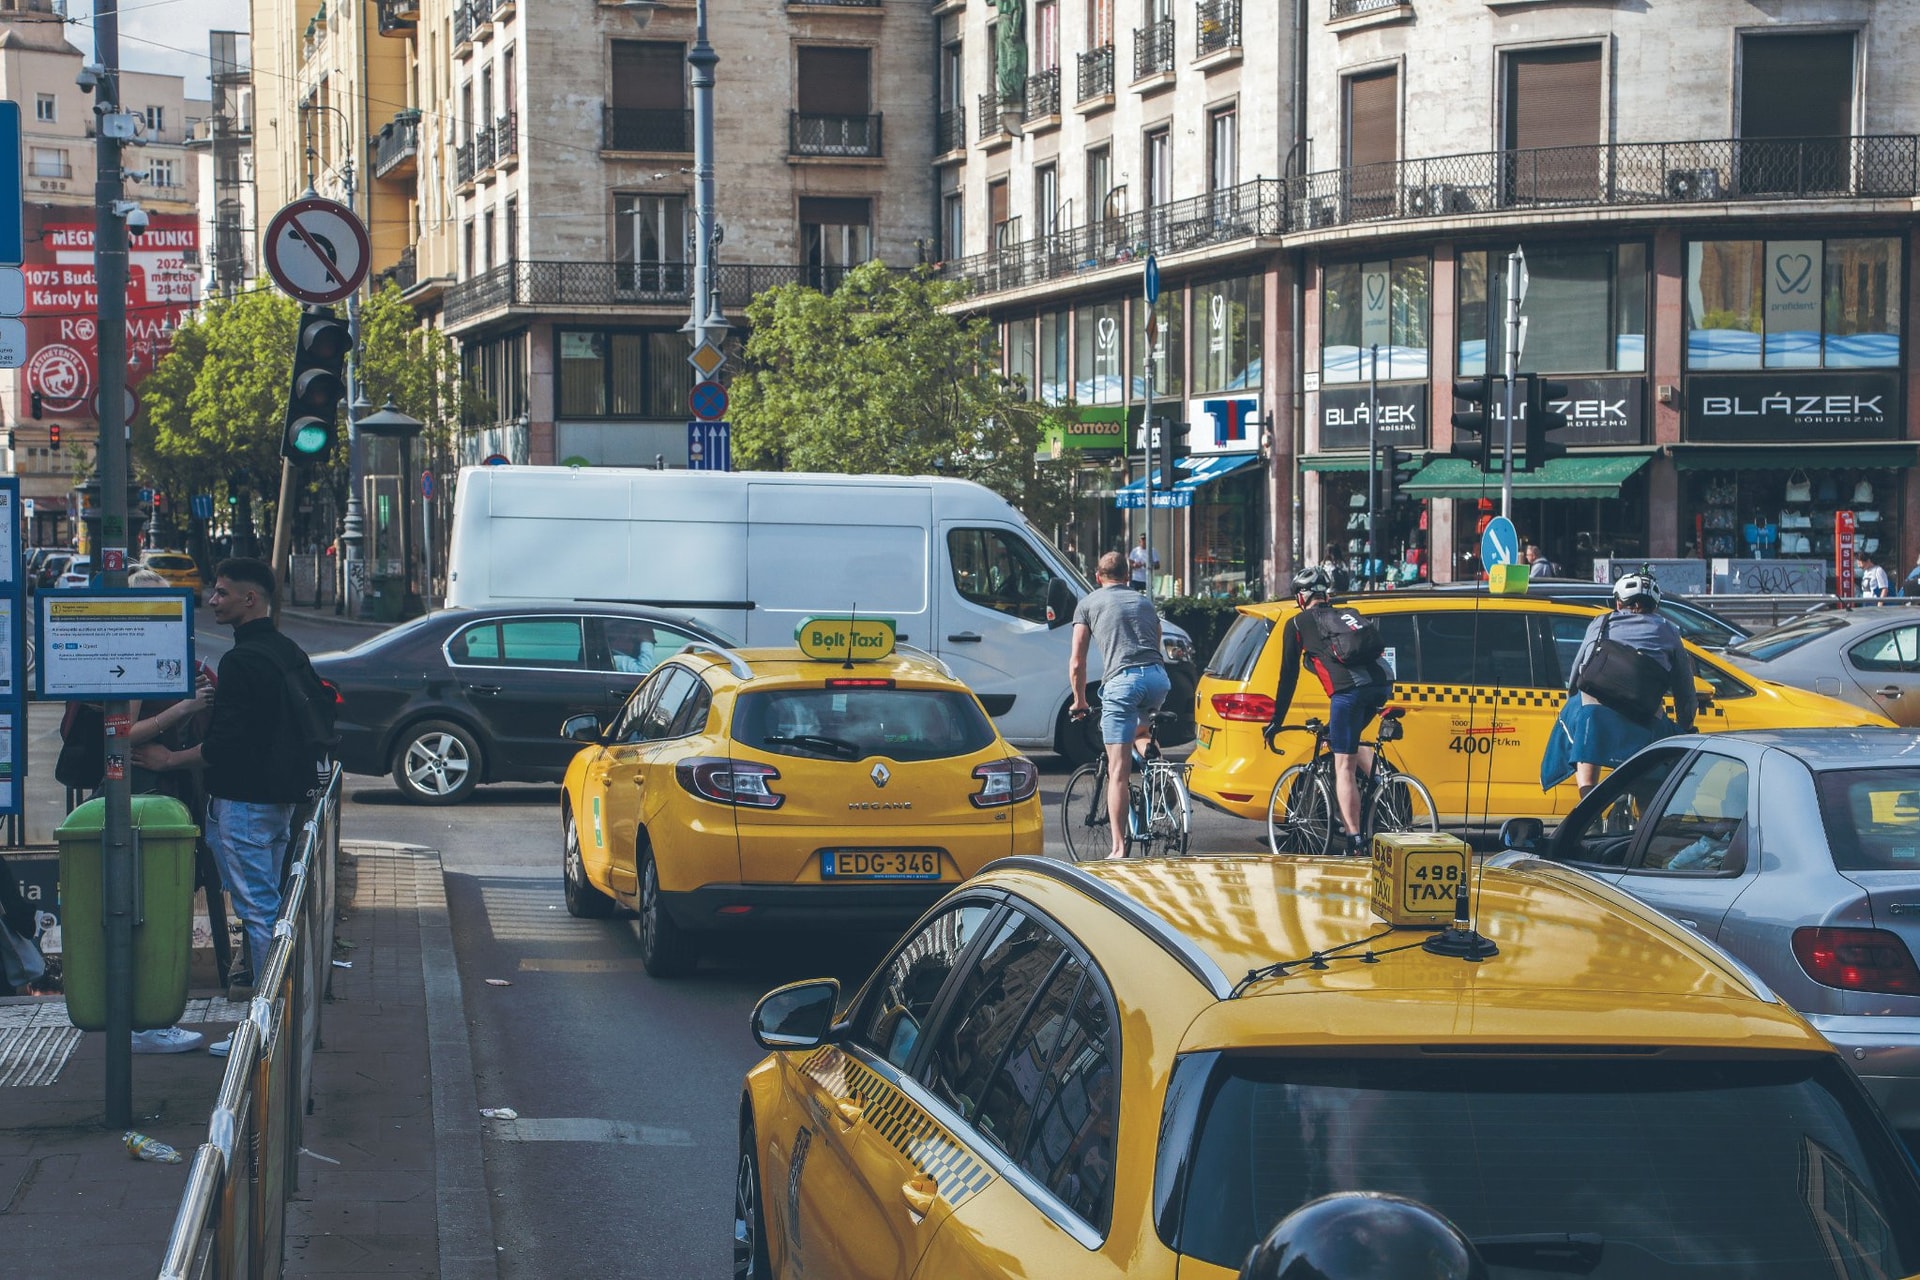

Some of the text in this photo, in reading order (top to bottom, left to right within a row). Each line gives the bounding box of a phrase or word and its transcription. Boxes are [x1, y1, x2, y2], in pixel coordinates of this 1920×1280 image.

[157, 259, 184, 269] 2022
[26, 271, 59, 285] 1075
[33, 290, 81, 309] Károly
[1704, 392, 1883, 415] BLÁZEK
[812, 631, 883, 651] Bolt Taxi
[1449, 735, 1491, 755] 400
[848, 802, 912, 810] MEGANE
[825, 865, 833, 873] H
[839, 853, 933, 873] EDG-346
[1415, 865, 1458, 881] 498
[1374, 877, 1391, 904] TAXI
